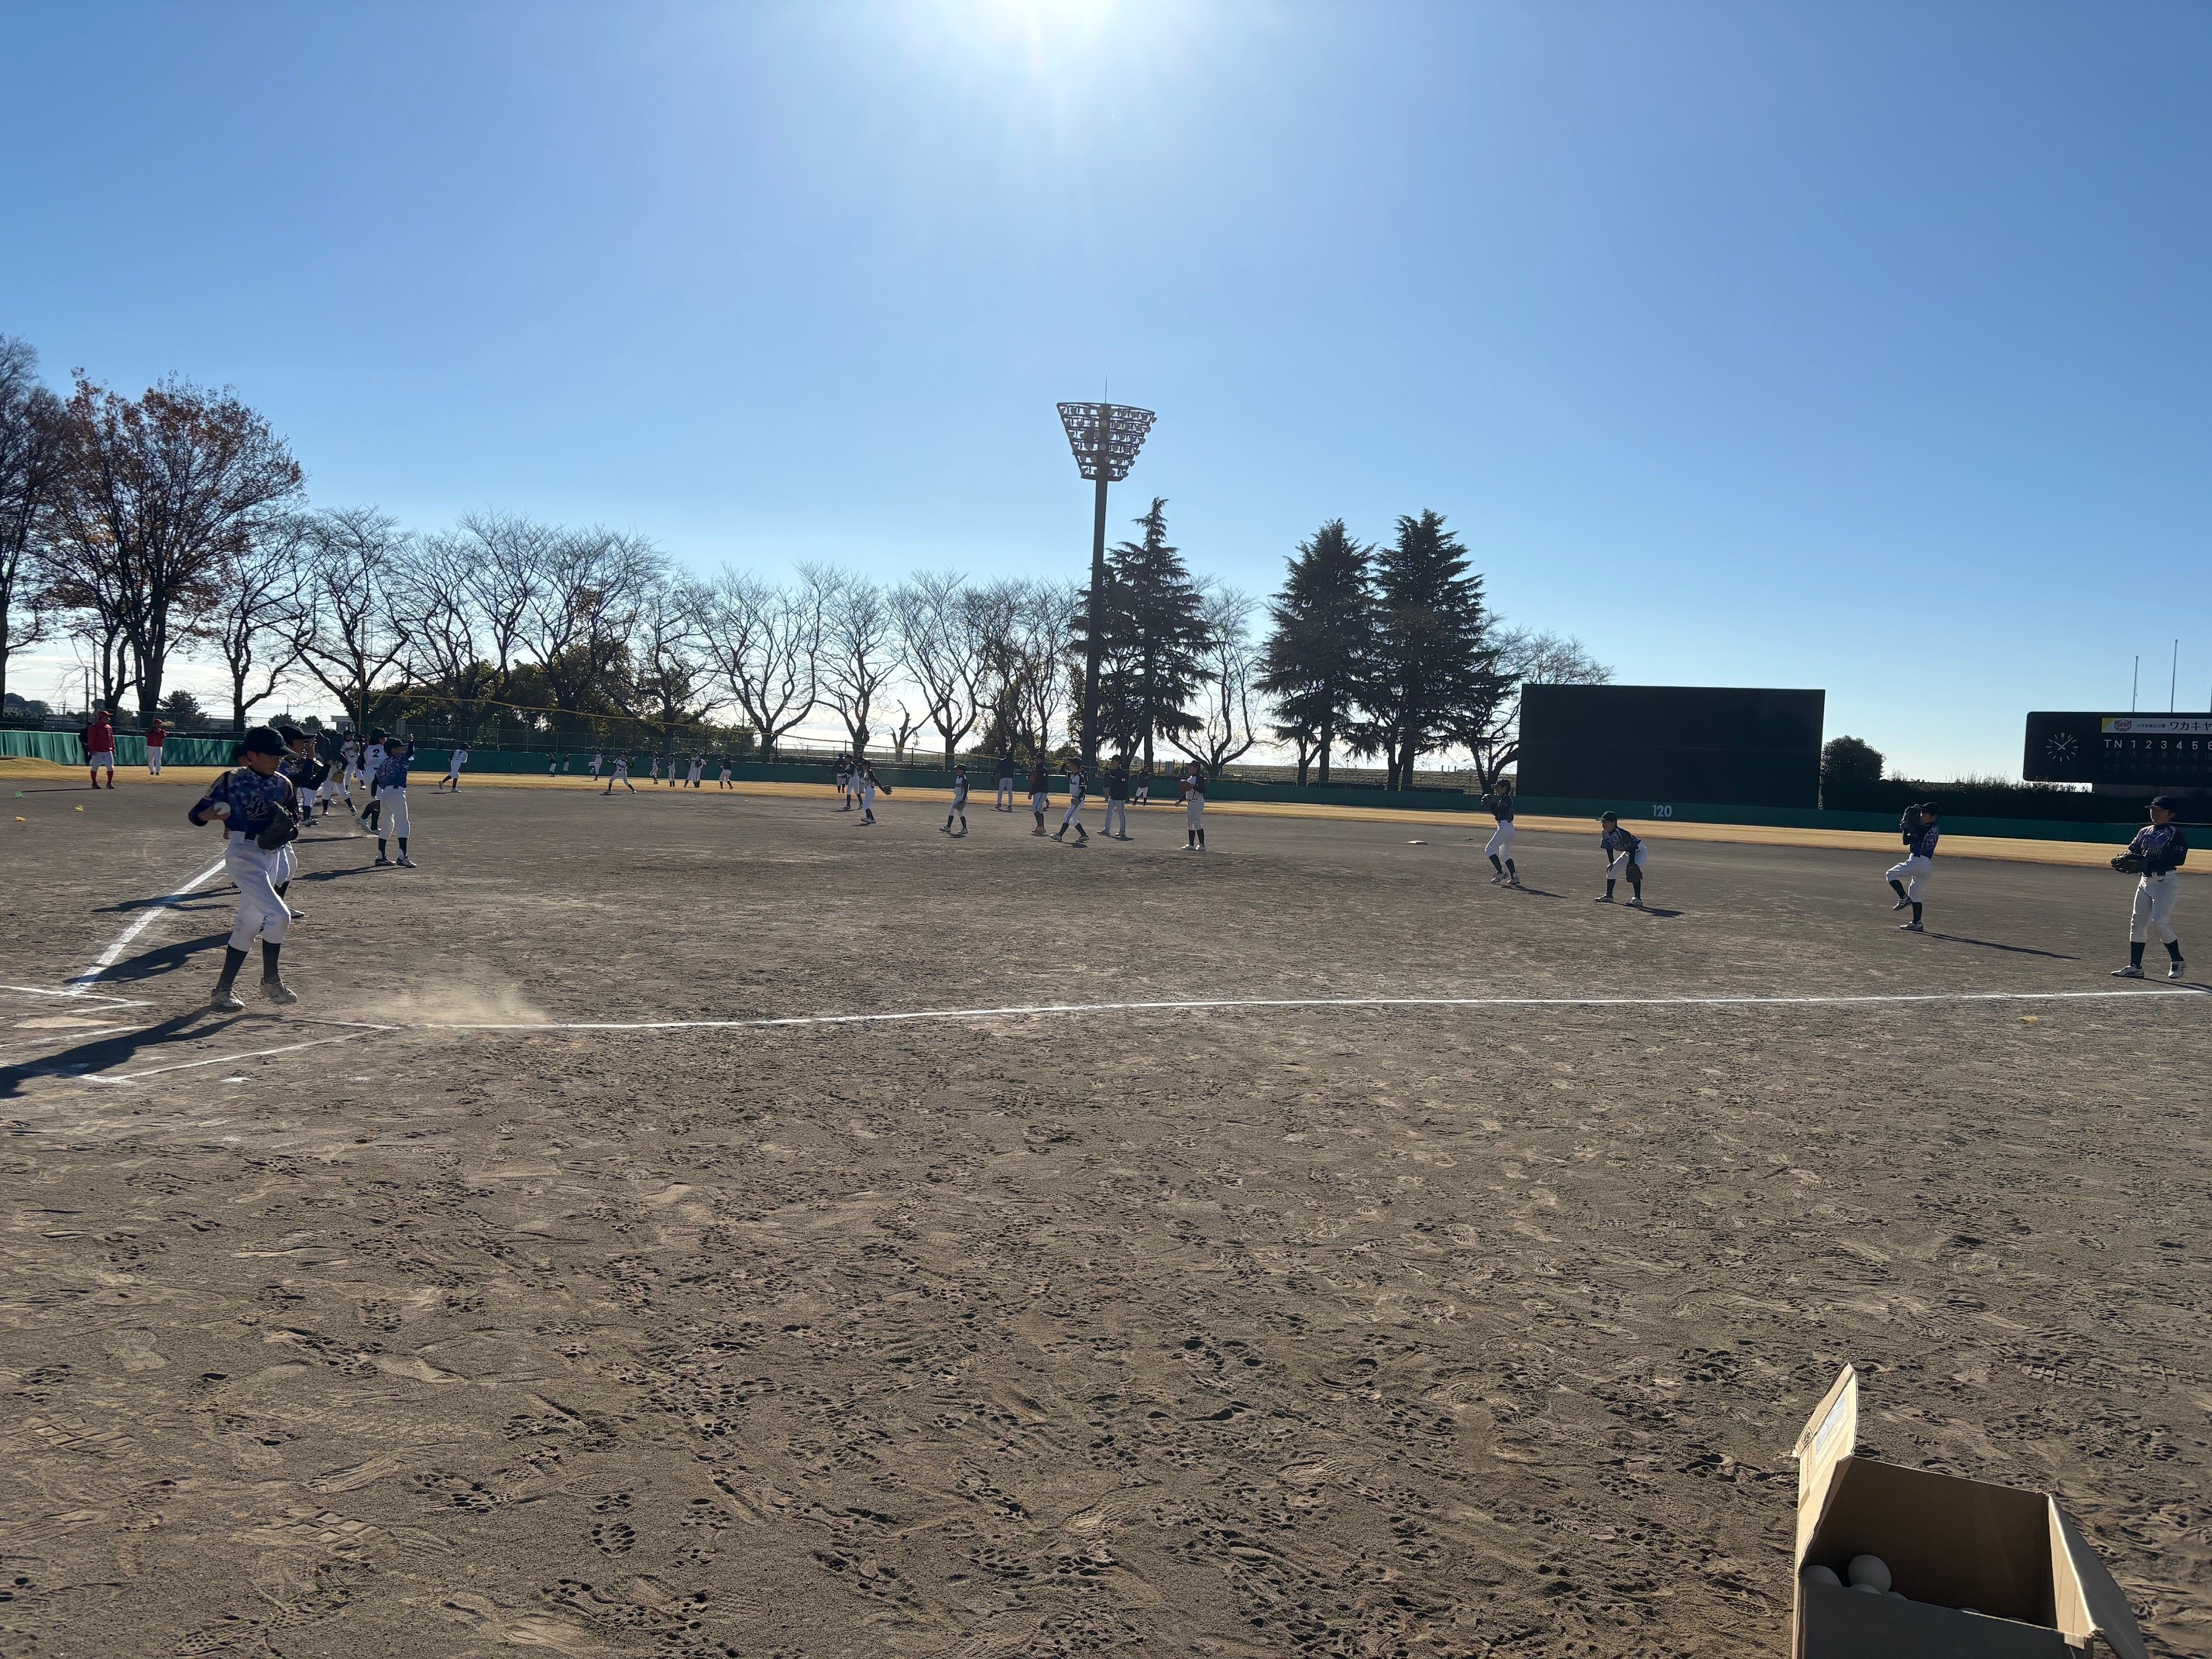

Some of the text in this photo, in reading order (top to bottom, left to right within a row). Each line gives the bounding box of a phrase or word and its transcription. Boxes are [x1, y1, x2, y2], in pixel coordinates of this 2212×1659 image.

[2131, 740, 2135, 749] 1
[2145, 740, 2152, 749] 2
[2161, 740, 2167, 749] 3
[2176, 740, 2183, 750] 4
[2192, 740, 2198, 750] 5
[373, 748, 380, 757] 2
[1652, 804, 1673, 817] 120
